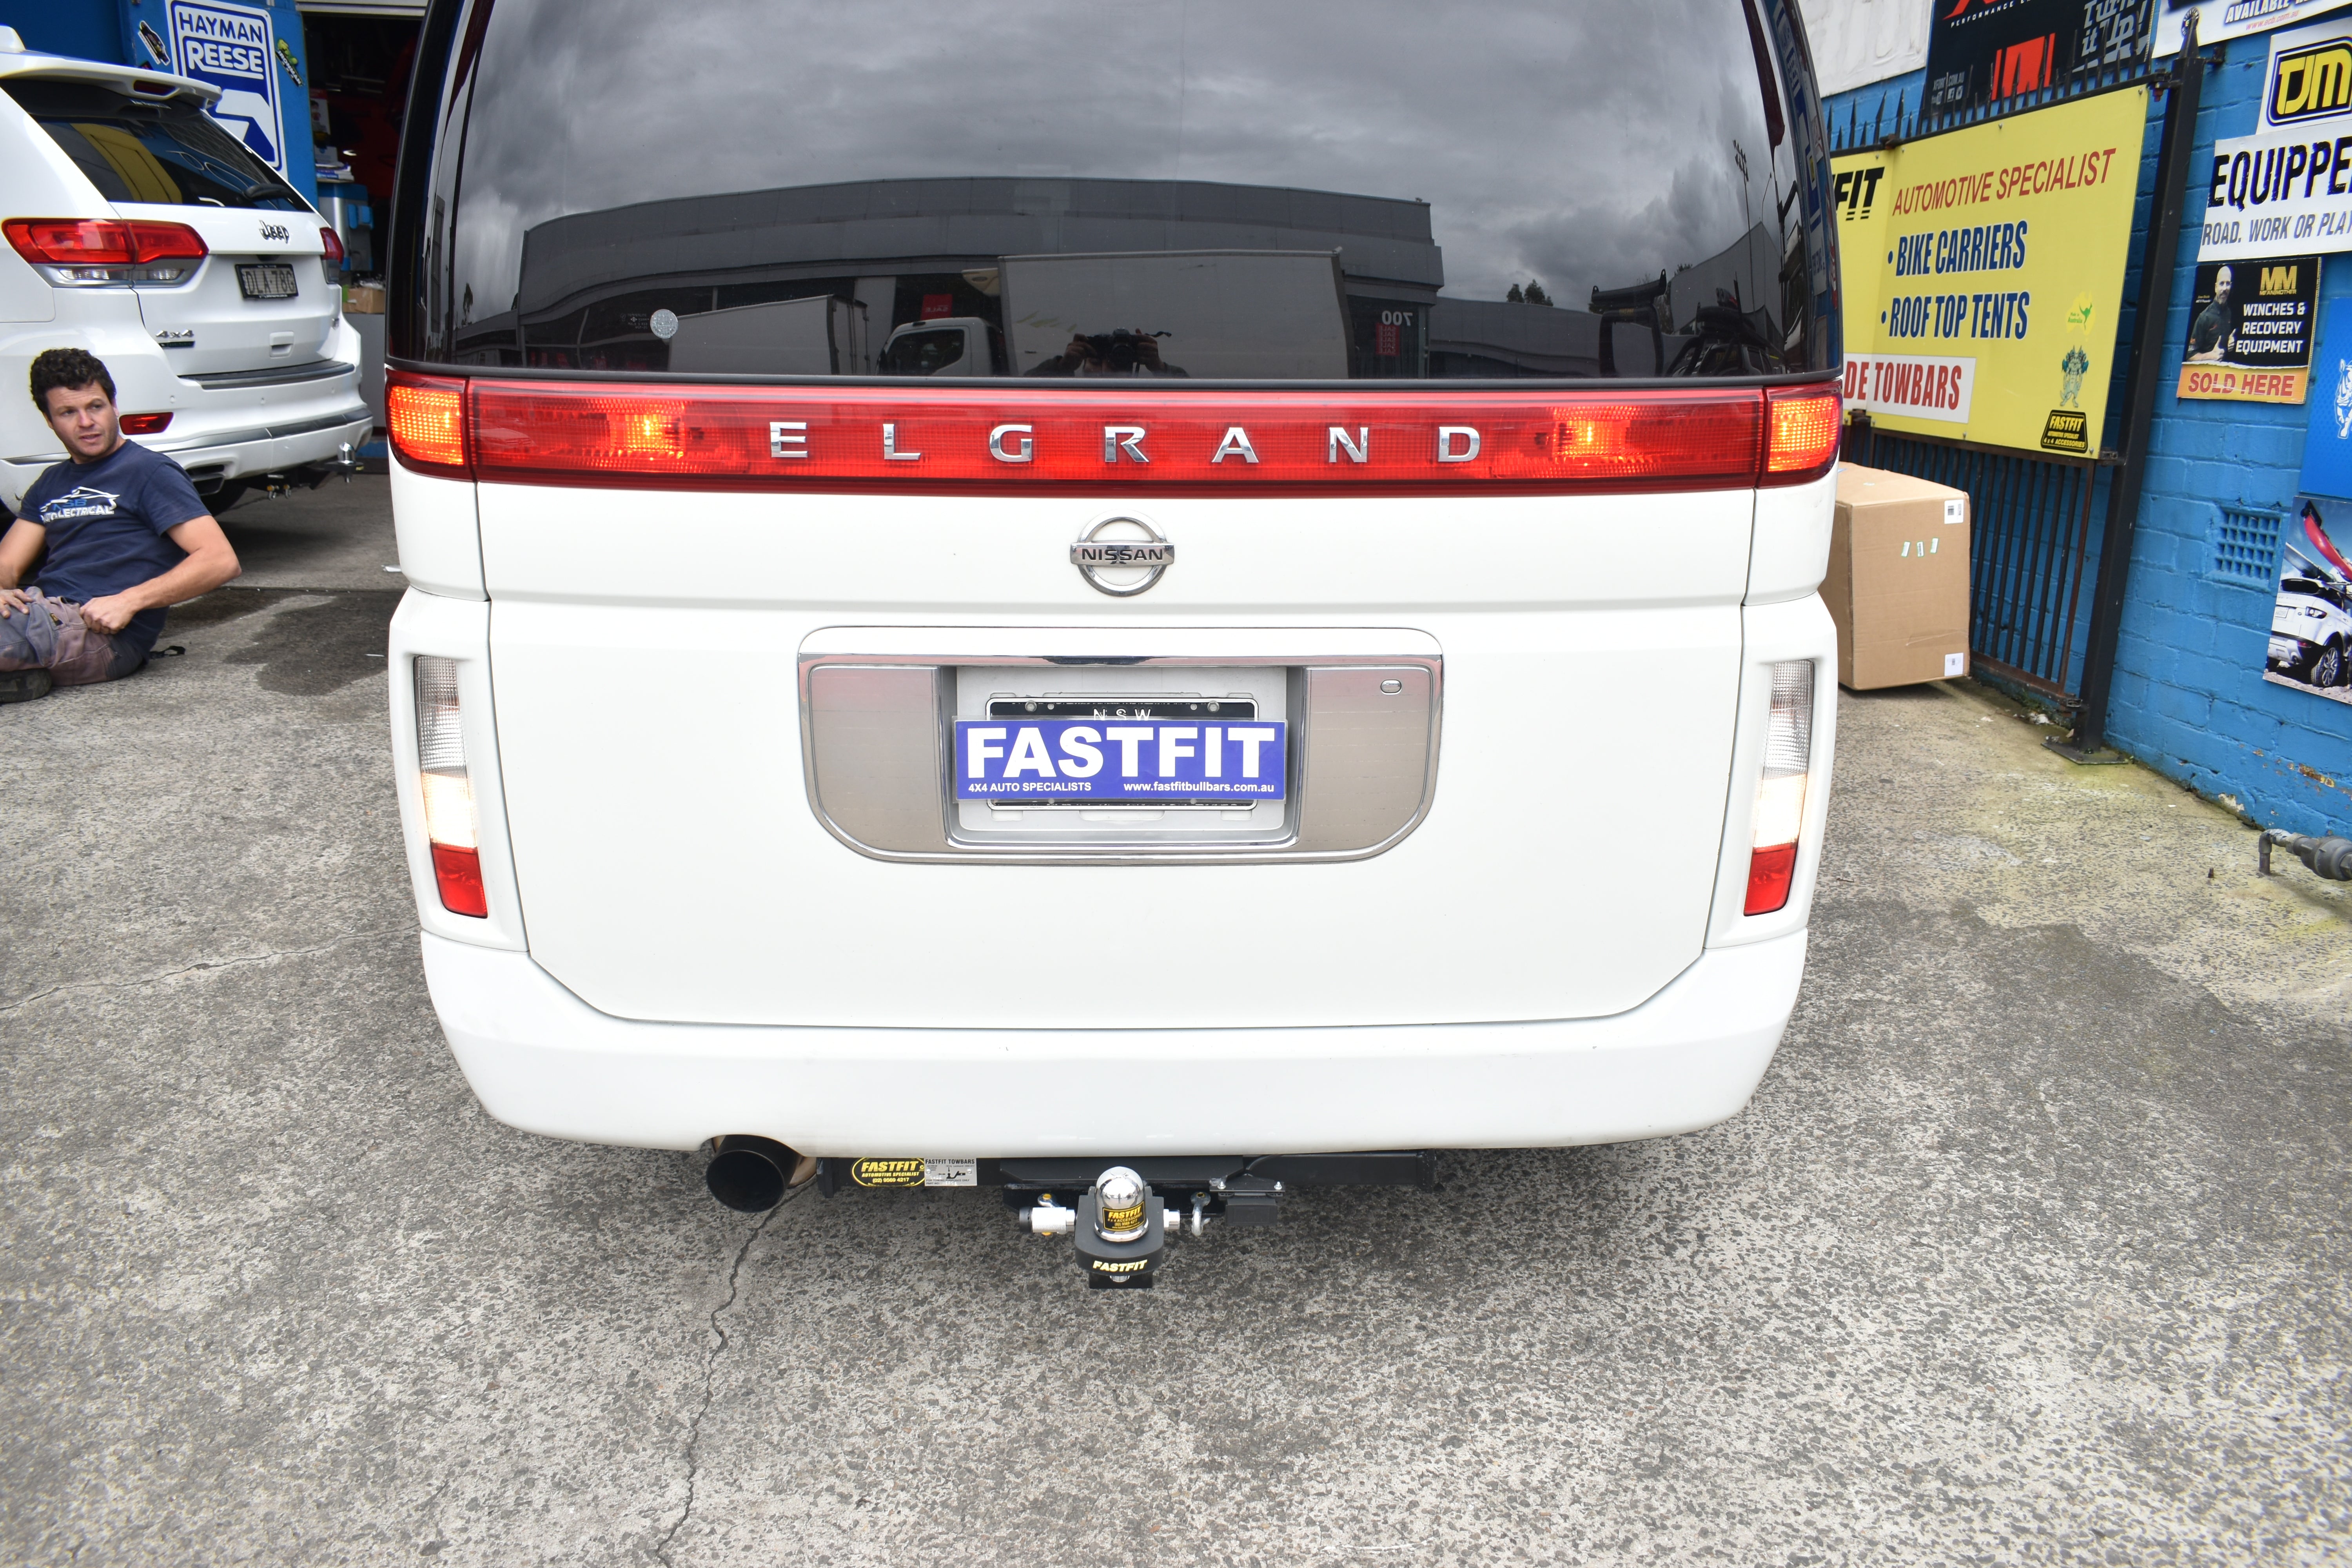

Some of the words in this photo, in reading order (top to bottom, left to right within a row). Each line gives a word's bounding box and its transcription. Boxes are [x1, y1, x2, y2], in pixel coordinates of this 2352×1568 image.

[1951, 1, 2013, 28] PERFORMANCE
[2225, 0, 2290, 23] AVAILABLE
[2245, 11, 2299, 31] www.ecb.com.au
[179, 11, 263, 44] HAYMAN
[2081, 25, 2097, 57] it
[186, 40, 264, 74] REESE
[2276, 48, 2352, 115] TJM
[1892, 171, 1994, 216] AUTOMOTIVE
[1996, 148, 2116, 200] SPECIALIST
[2208, 136, 2352, 212] EQUIPPE
[259, 220, 290, 244] Jeep
[2201, 221, 2242, 246] ROAD.
[2249, 216, 2292, 242] WORK
[2294, 214, 2313, 238] OR
[1896, 233, 1934, 276] BIKE
[1935, 220, 2028, 274] CARRIERS
[2260, 265, 2298, 290] MM
[1889, 295, 1932, 337] ROOF
[1934, 295, 1967, 339] TOP
[1971, 291, 2030, 339] TENTS
[2243, 303, 2294, 316] WINCHES
[2297, 302, 2306, 315] &
[156, 329, 194, 338] 4x4
[2242, 321, 2302, 334] RECOVERY
[2236, 340, 2303, 355] EQUIPMENT
[1873, 362, 1962, 410] TOWBARS
[2188, 372, 2236, 394] SOLD
[2240, 374, 2296, 397] HERE
[2049, 416, 2084, 432] FASTFIT
[770, 421, 1480, 465] ELGRAND
[2054, 439, 2085, 448] ACCESSORIES
[1082, 548, 1163, 561] NISSAN
[967, 726, 1275, 778] FASTFIT
[968, 783, 988, 792] 4X4
[989, 782, 1020, 792] AUTO
[1022, 782, 1092, 791] SPECIALISTS
[1123, 781, 1275, 792] www.fastfitbullbars.com.au
[861, 1161, 919, 1172] FASTFIT
[1108, 1206, 1142, 1219] FASTFIT
[1117, 1212, 1142, 1222] ACCESSORIES
[1092, 1259, 1148, 1272] FASTFIT
